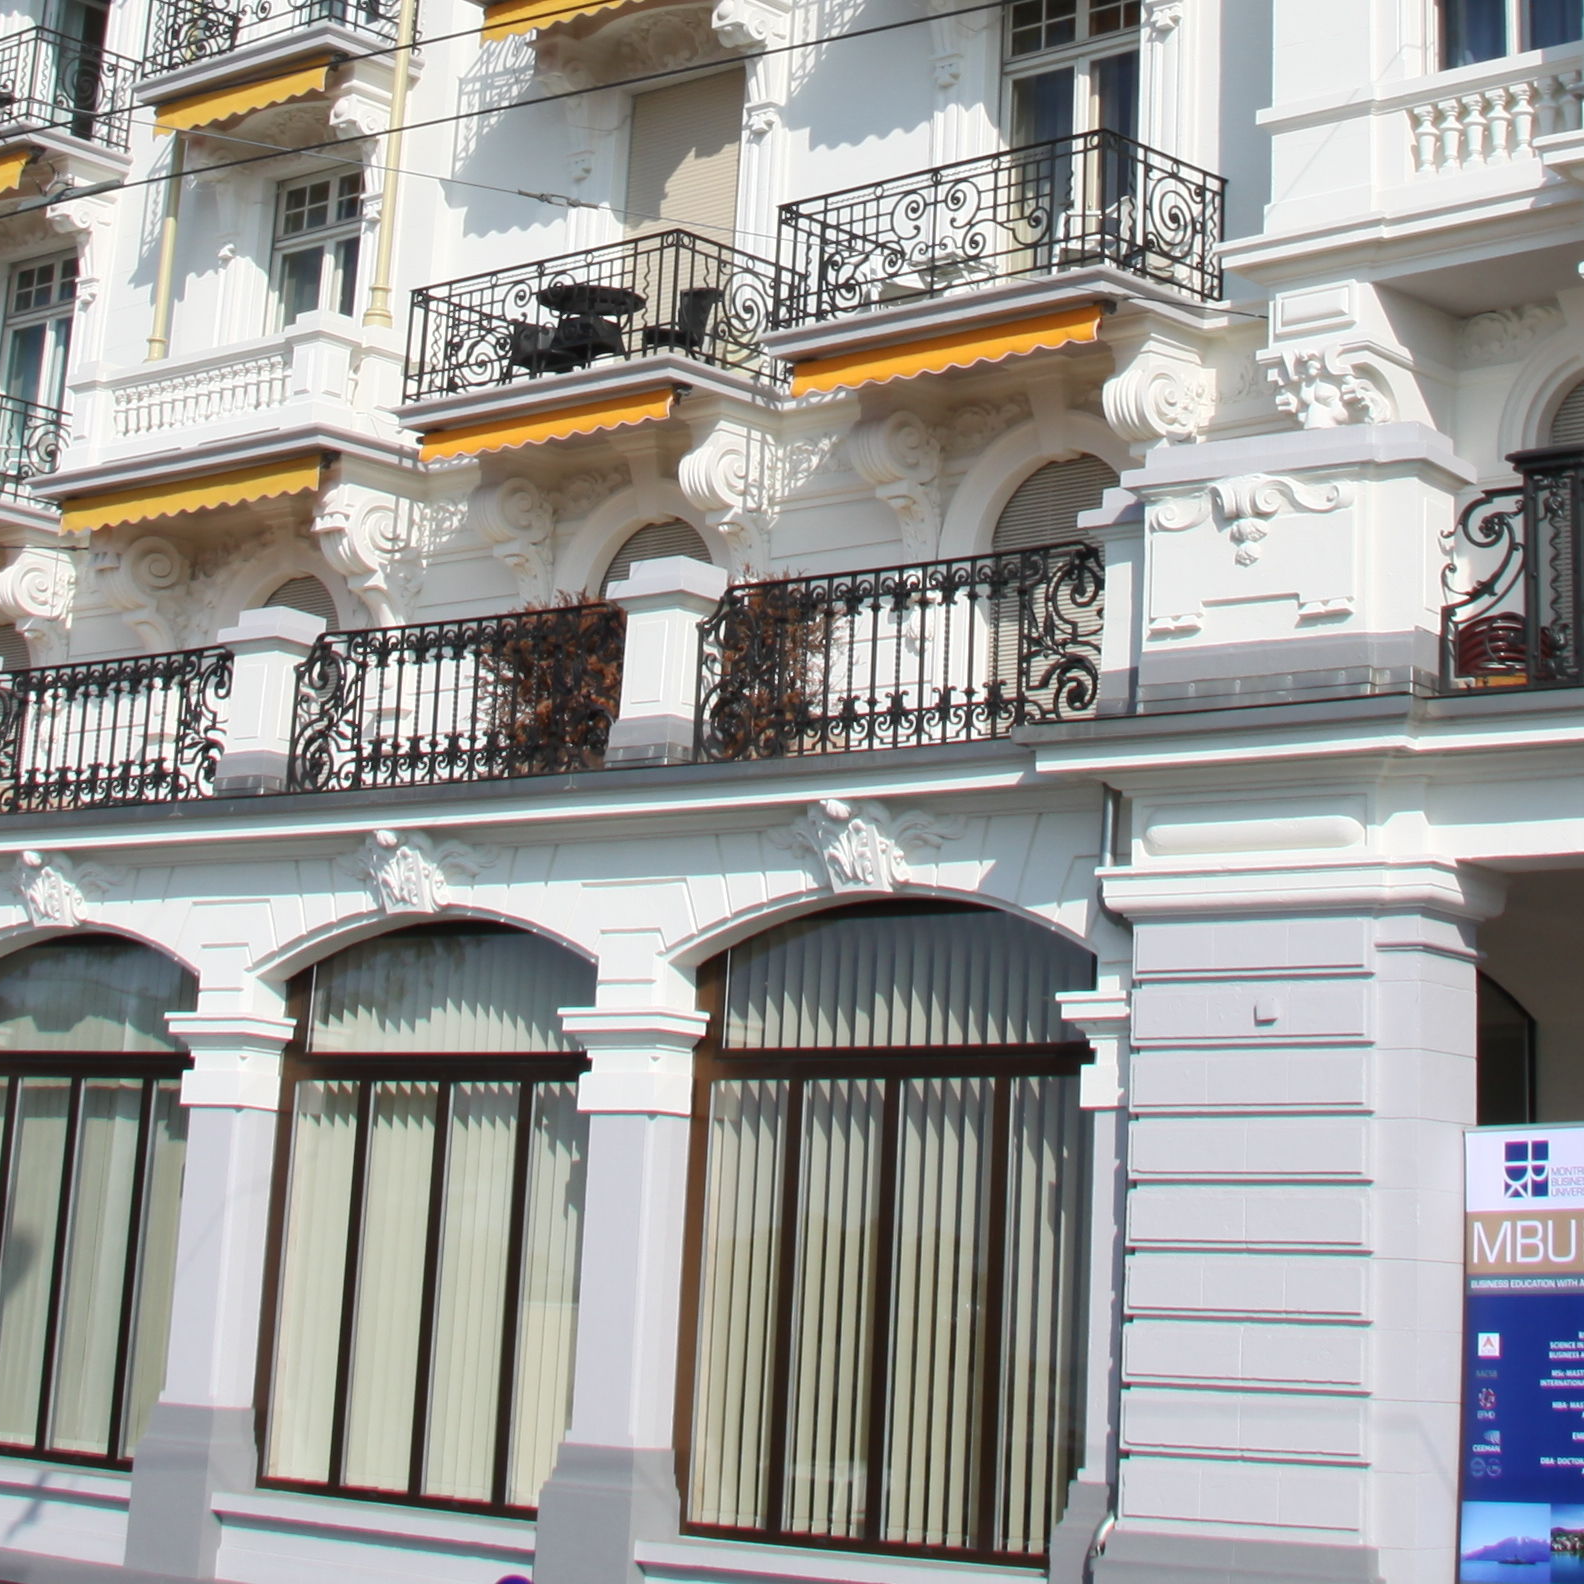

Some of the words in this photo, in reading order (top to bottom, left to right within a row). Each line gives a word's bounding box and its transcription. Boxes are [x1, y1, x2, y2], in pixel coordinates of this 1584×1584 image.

[1472, 1219, 1577, 1264] MBU
[1471, 1279, 1509, 1289] BUSINESS
[1510, 1278, 1556, 1289] EDUCATION
[1556, 1278, 1578, 1288] WITH
